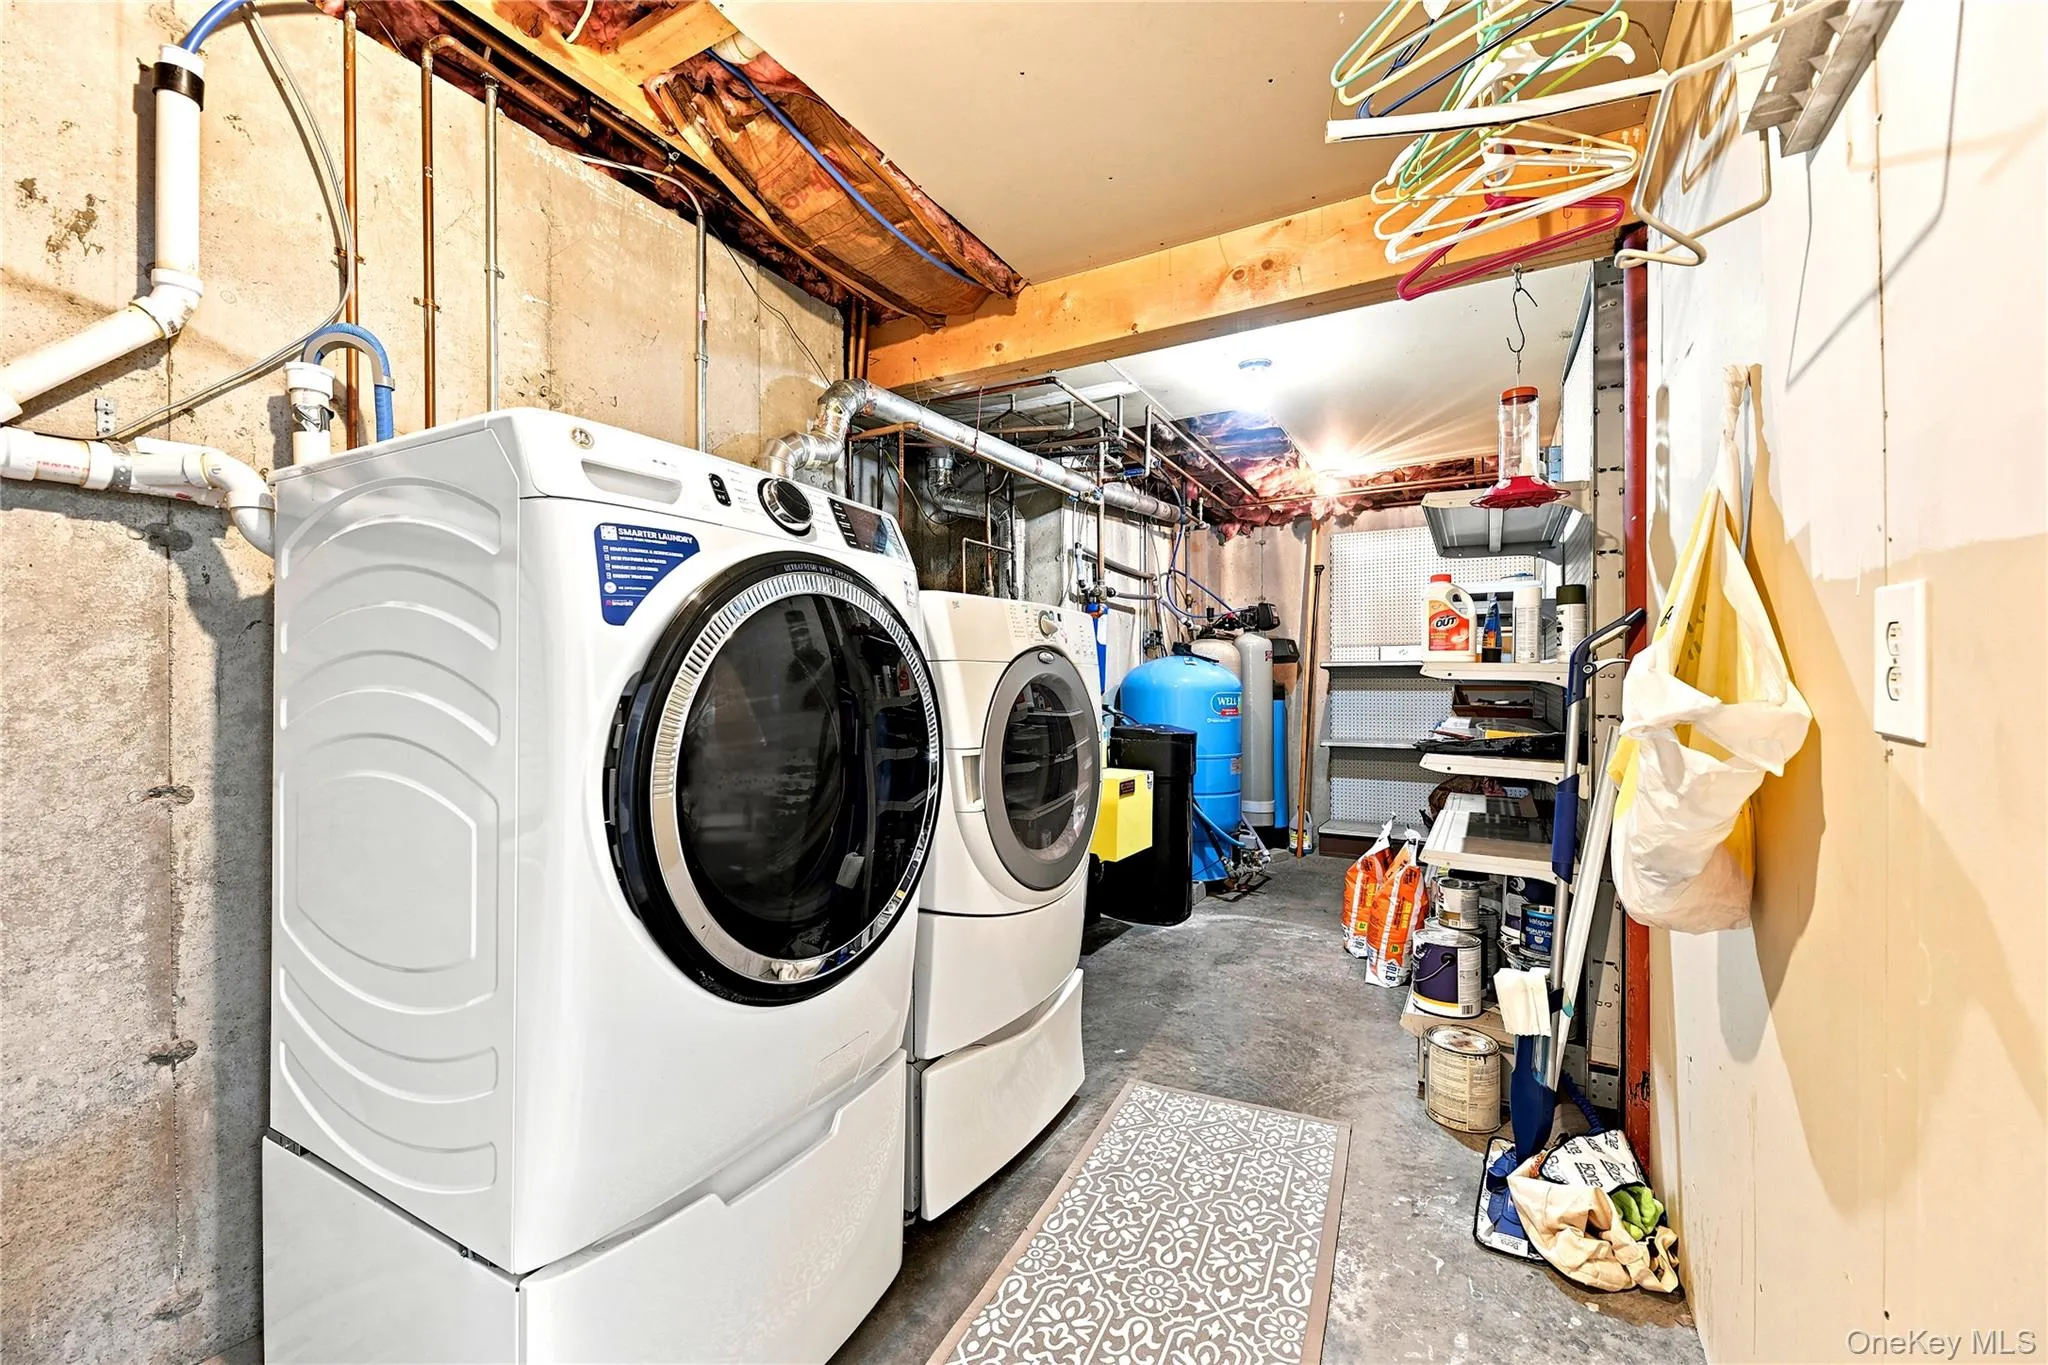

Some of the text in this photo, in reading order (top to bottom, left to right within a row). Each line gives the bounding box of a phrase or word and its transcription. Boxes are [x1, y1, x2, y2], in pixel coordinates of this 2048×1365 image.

[618, 528, 657, 538] SMARTER
[658, 533, 692, 543] LAUNDRY
[819, 565, 833, 574] VENT
[1436, 617, 1457, 628] OUT
